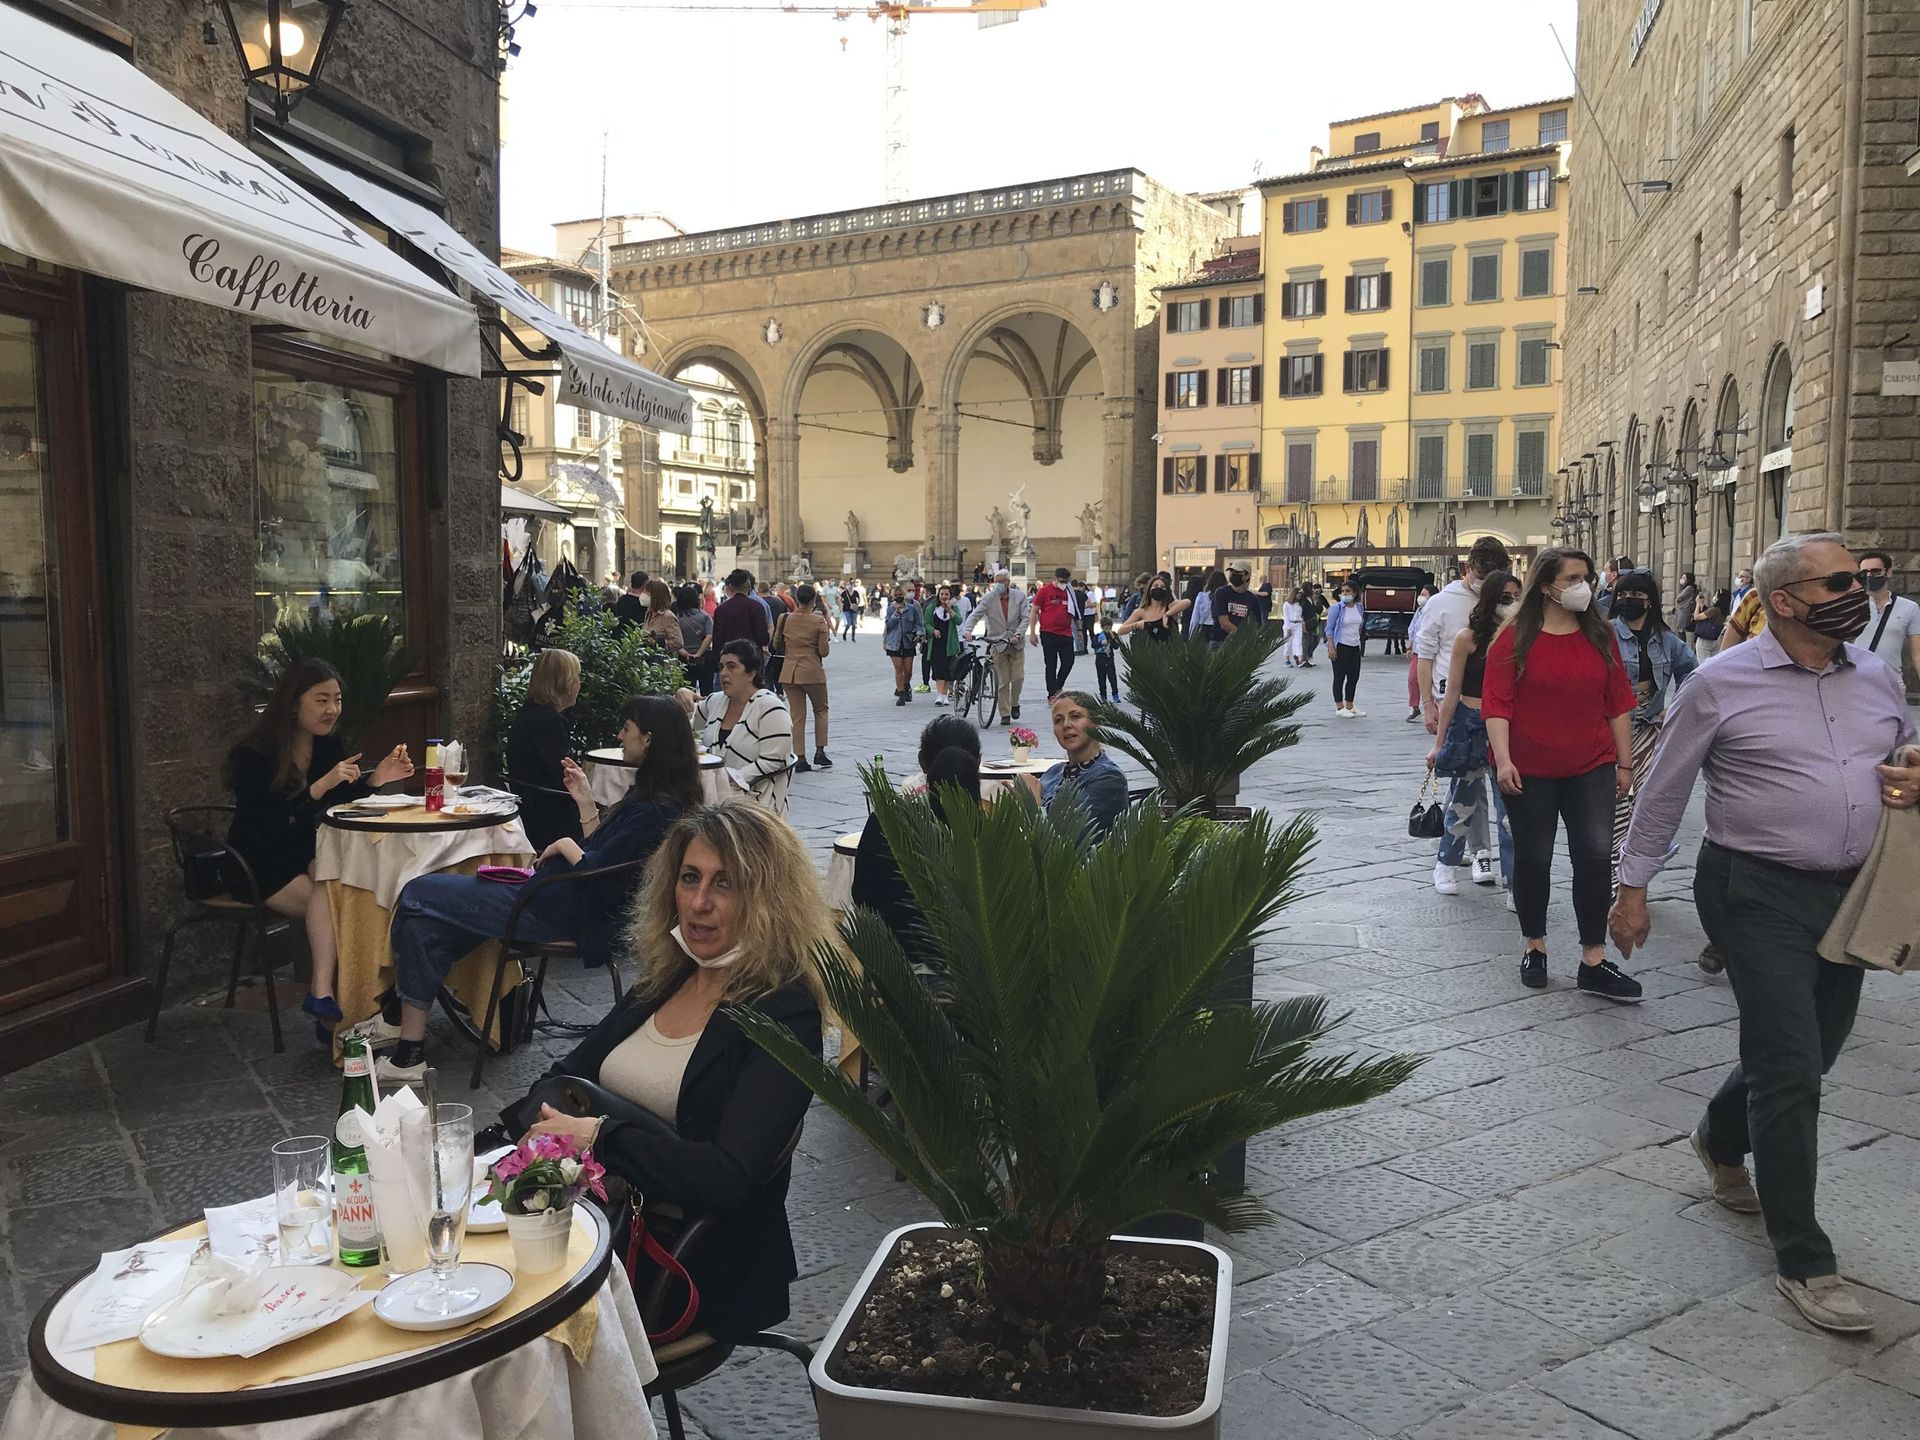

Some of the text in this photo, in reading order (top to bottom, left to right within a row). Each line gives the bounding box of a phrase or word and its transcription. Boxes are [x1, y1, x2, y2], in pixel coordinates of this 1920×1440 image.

[182, 233, 376, 330] Caffetteria
[568, 364, 689, 425] Gelato Artigianale
[338, 1202, 374, 1222] PANN
[346, 1195, 369, 1205] ACQUA
